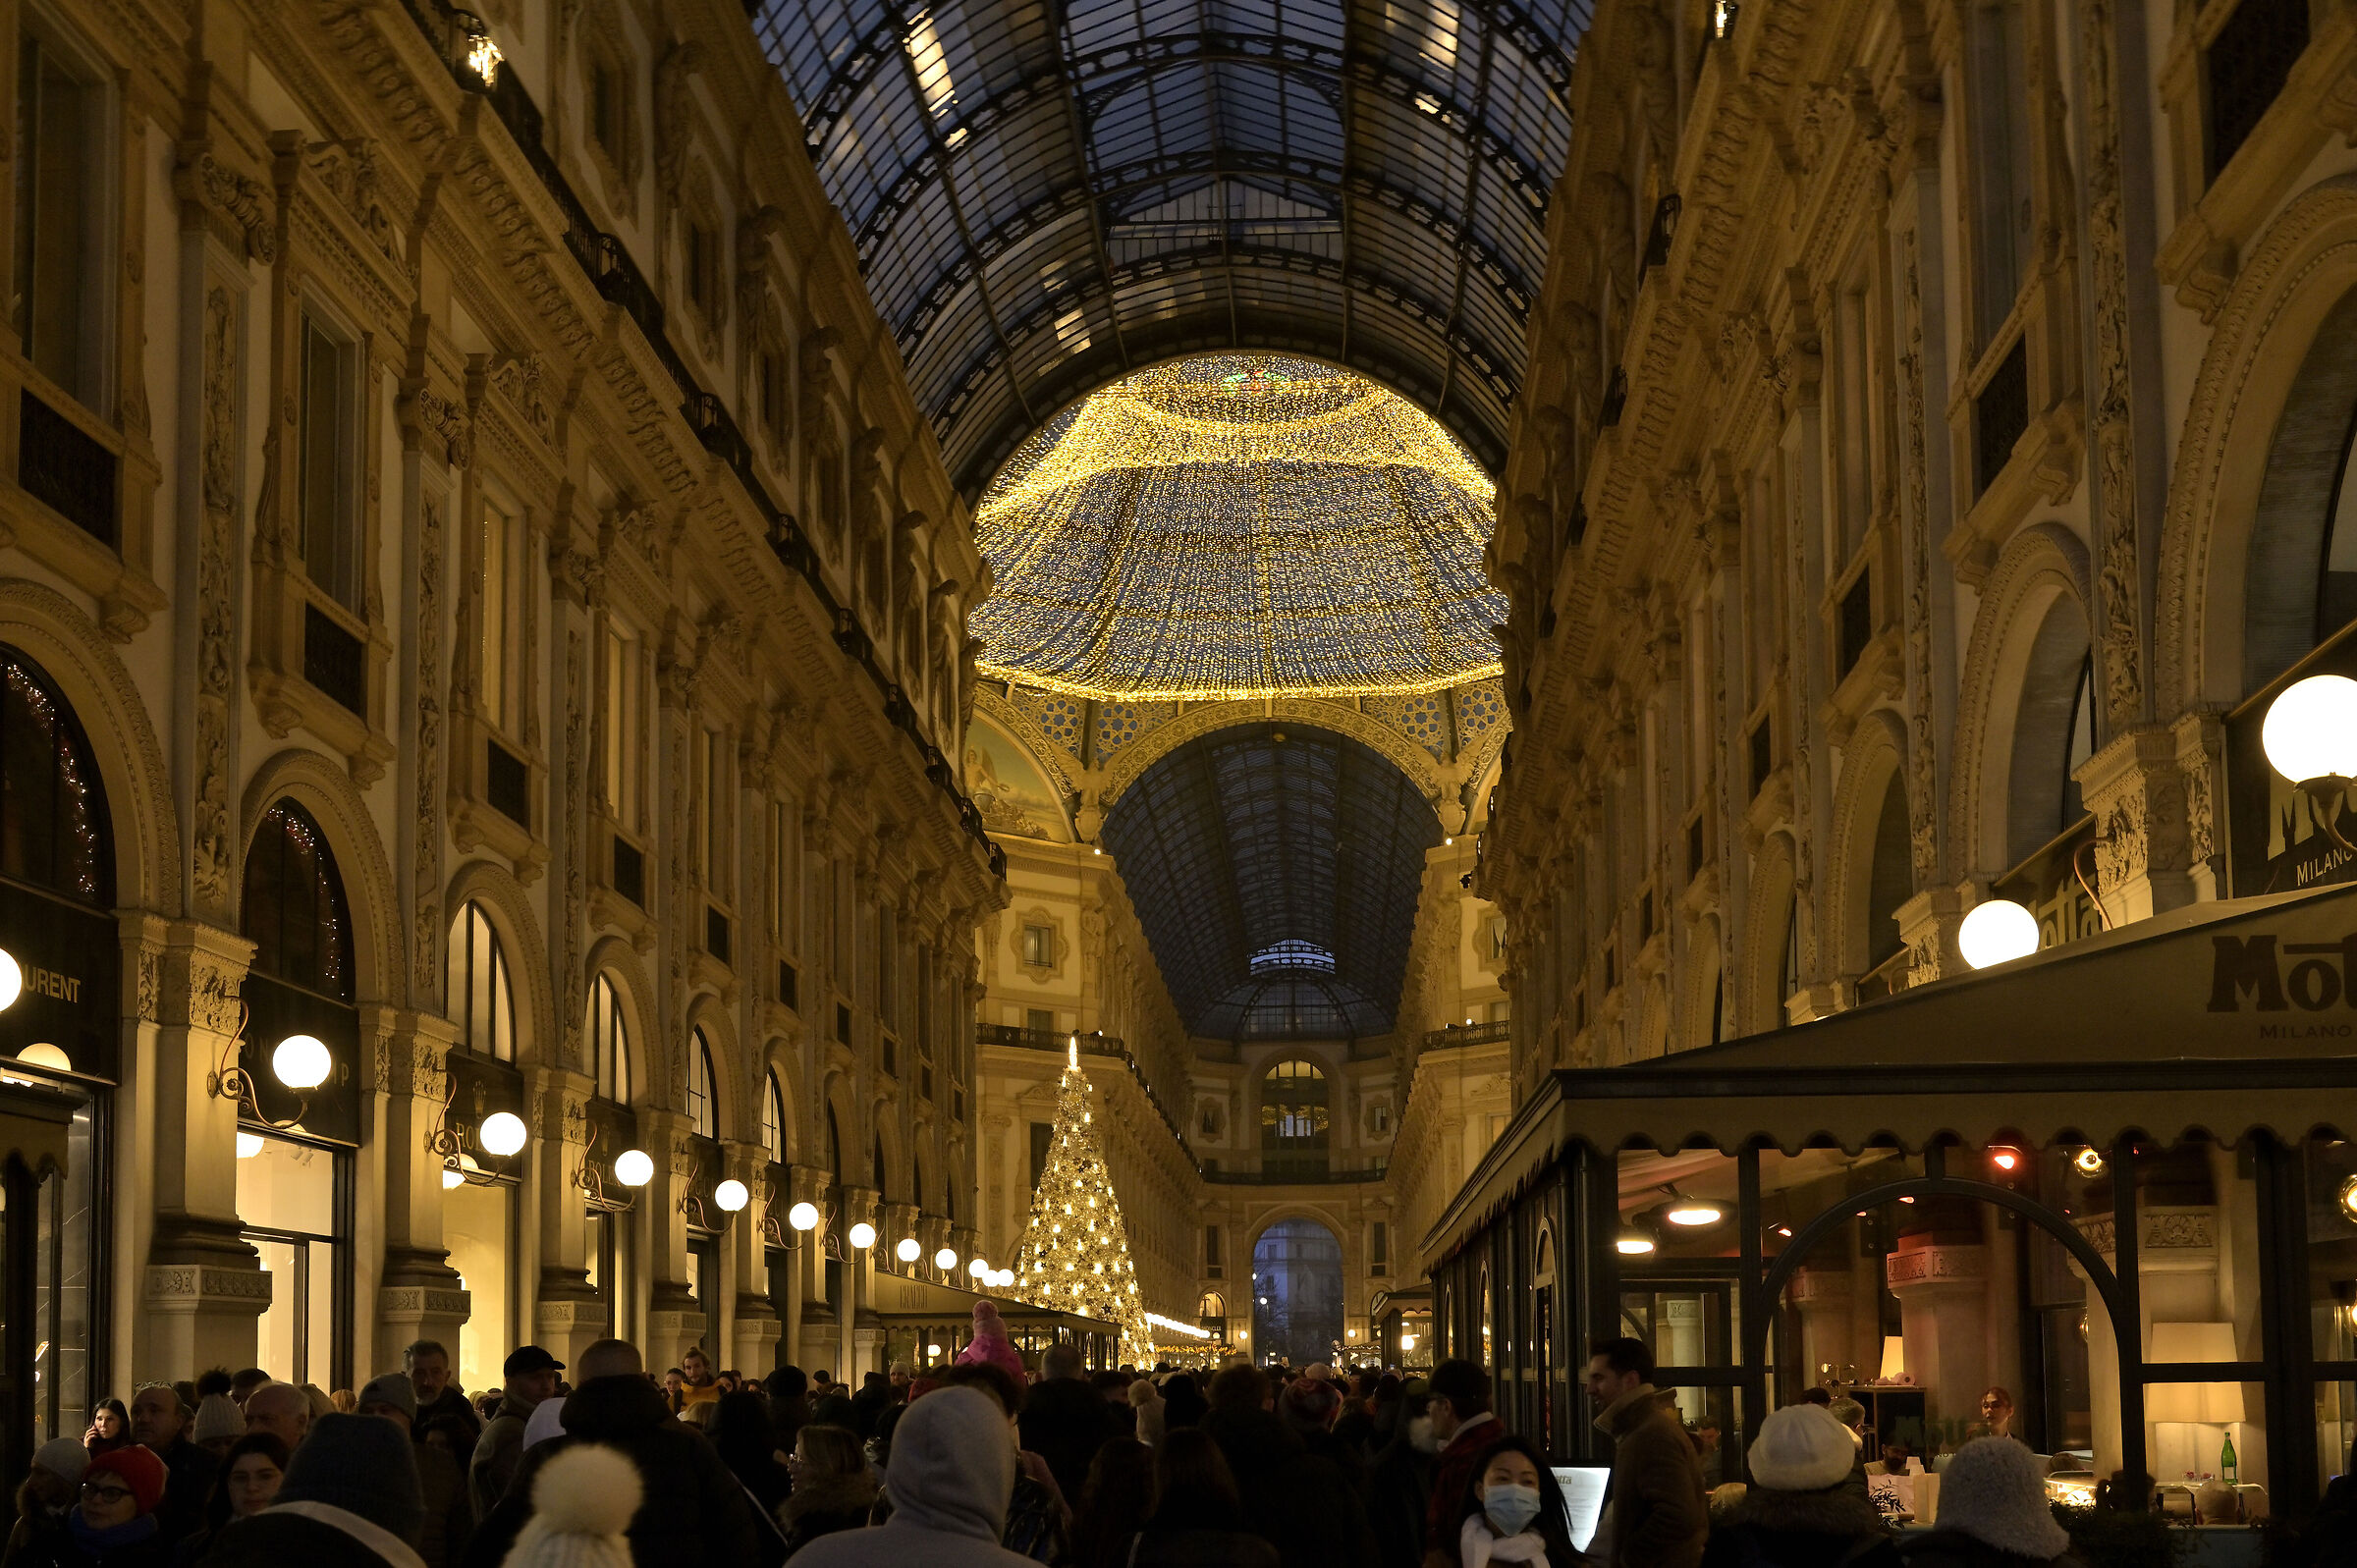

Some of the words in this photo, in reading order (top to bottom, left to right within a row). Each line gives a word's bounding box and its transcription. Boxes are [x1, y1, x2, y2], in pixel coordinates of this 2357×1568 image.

[2029, 871, 2102, 950] otta
[25, 964, 82, 1003] URENT
[2260, 1024, 2352, 1039] MILANO
[456, 1122, 481, 1151] ROL
